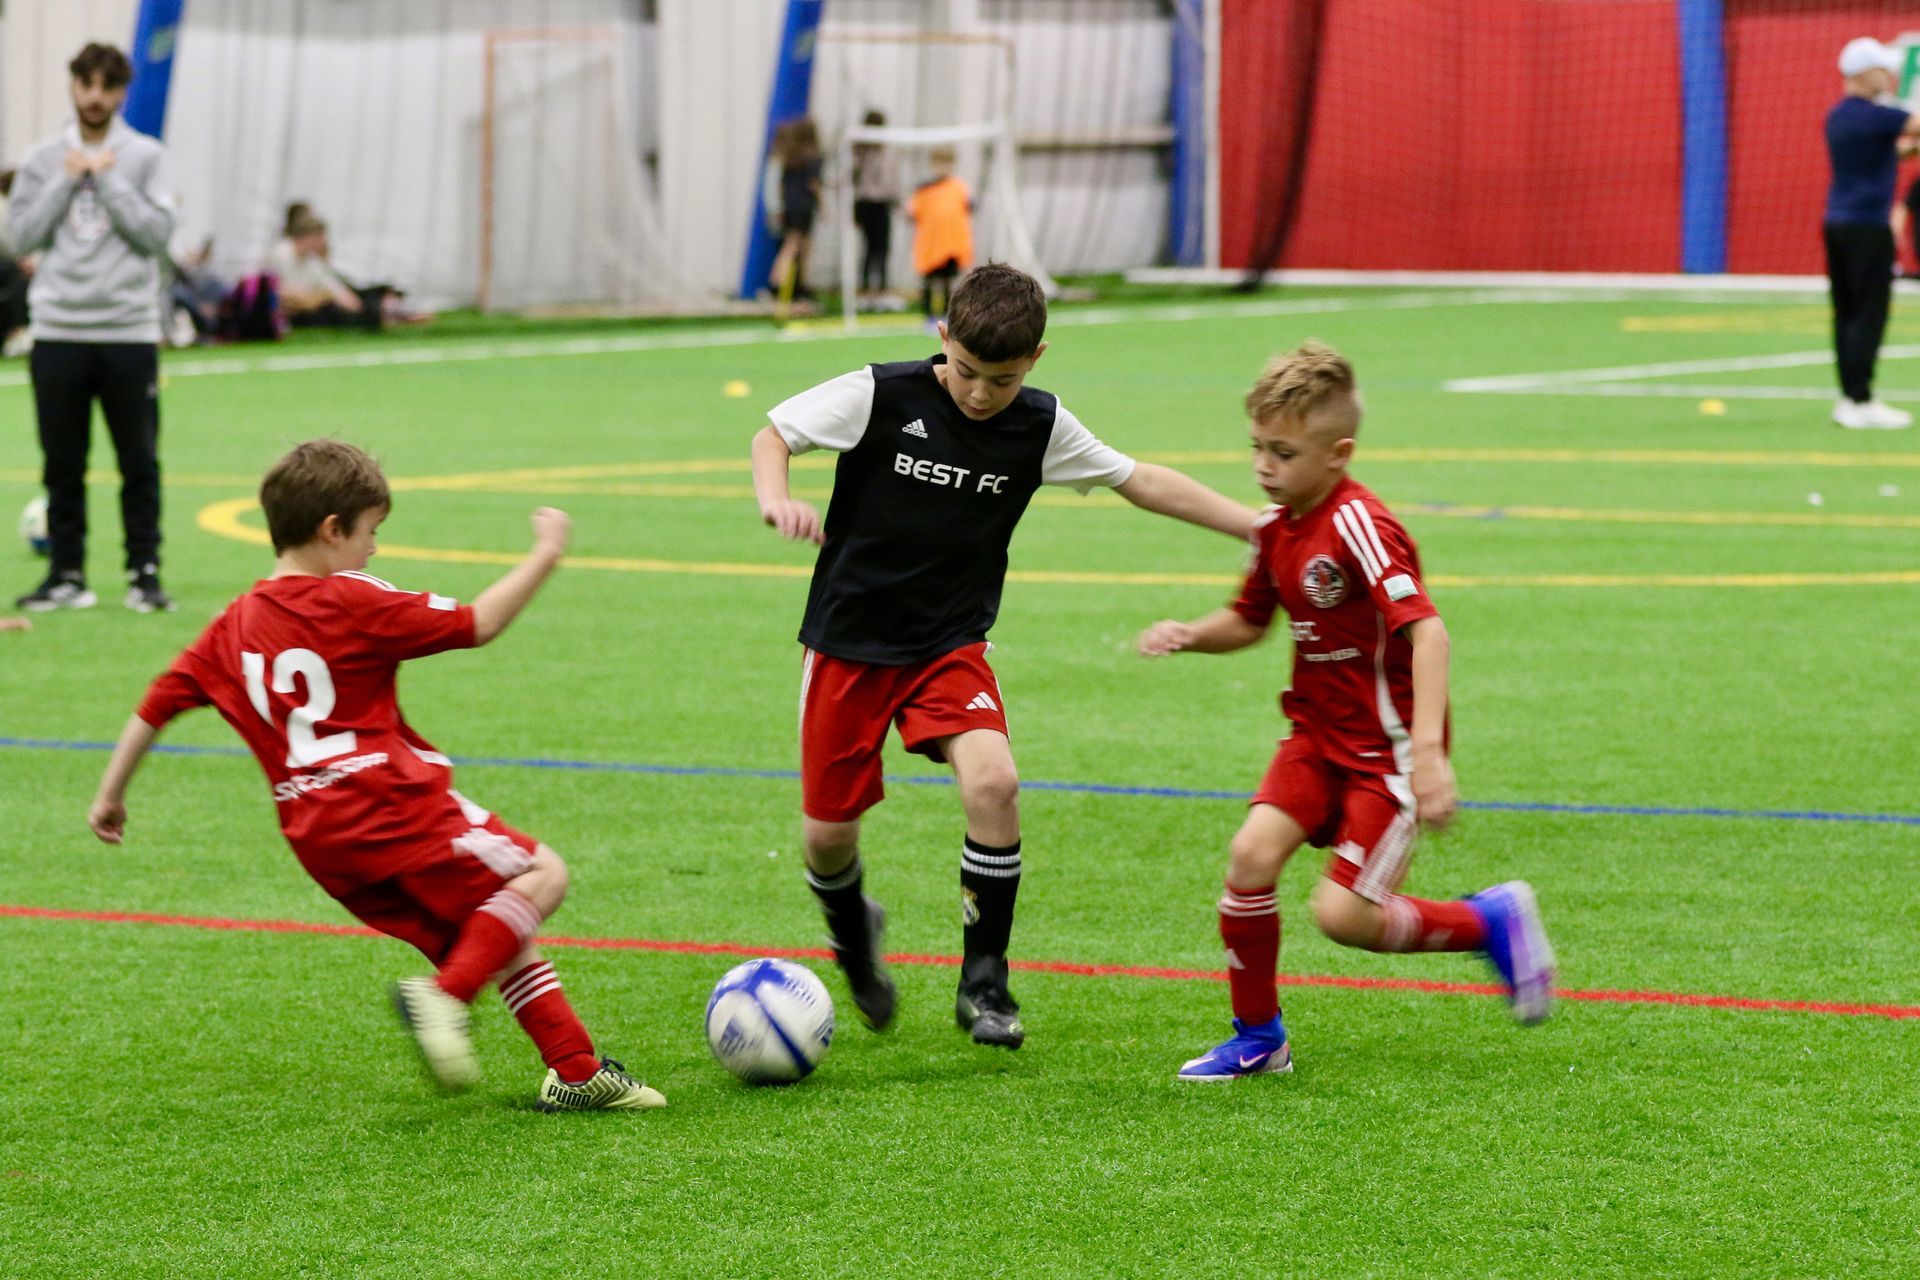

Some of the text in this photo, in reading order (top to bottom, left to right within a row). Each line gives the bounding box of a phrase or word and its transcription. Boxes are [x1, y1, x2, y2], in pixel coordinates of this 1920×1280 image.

[894, 452, 1009, 494] BEST FC
[241, 647, 357, 768] 12
[546, 1084, 592, 1108] PUMA
